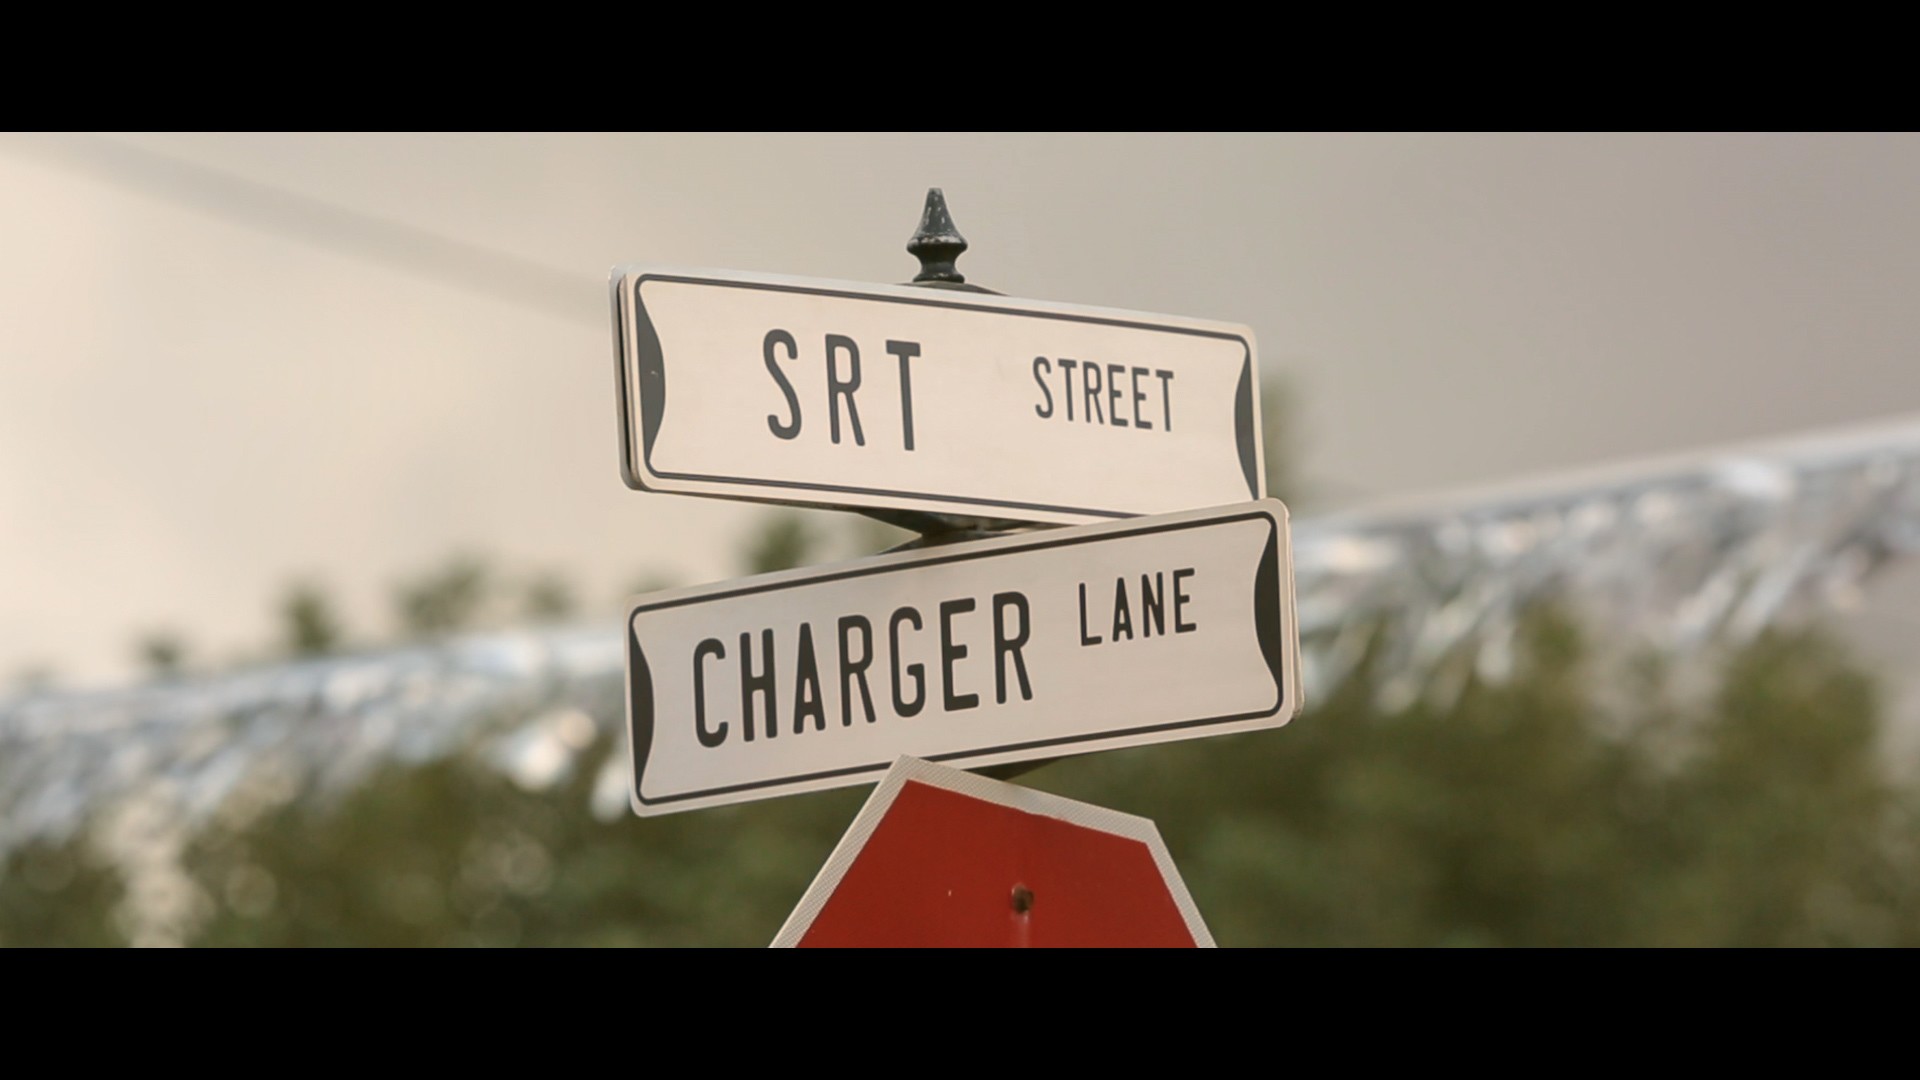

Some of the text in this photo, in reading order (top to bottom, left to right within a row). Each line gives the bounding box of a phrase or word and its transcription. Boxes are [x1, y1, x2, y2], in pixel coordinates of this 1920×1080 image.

[763, 329, 1174, 451] SRT STREET
[693, 567, 1197, 749] CHARGER LANE
